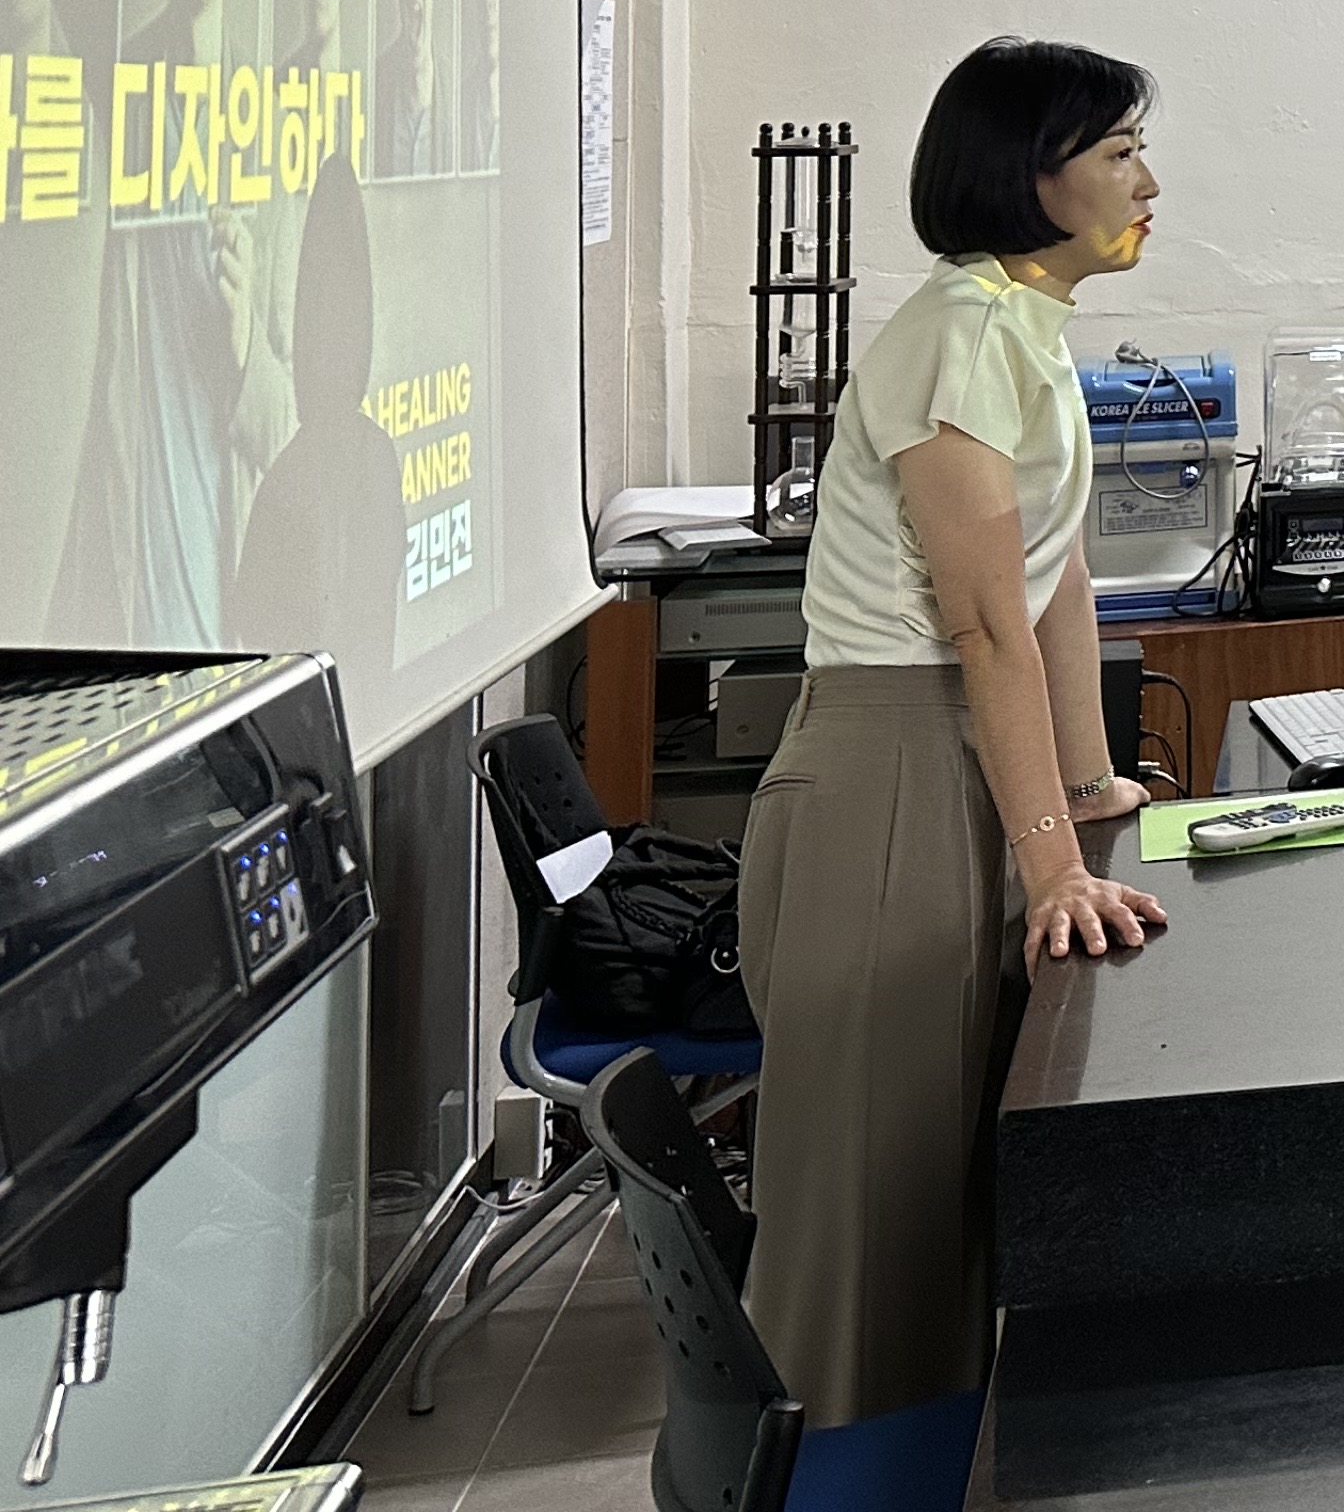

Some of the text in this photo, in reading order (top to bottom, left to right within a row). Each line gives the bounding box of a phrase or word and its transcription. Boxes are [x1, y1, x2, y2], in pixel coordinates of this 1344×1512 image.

[109, 60, 366, 212] 디자인하다
[377, 361, 472, 439] HEALING
[1090, 403, 1130, 418] KOREA
[1151, 400, 1189, 415] SLICER
[405, 498, 473, 603] 김민진
